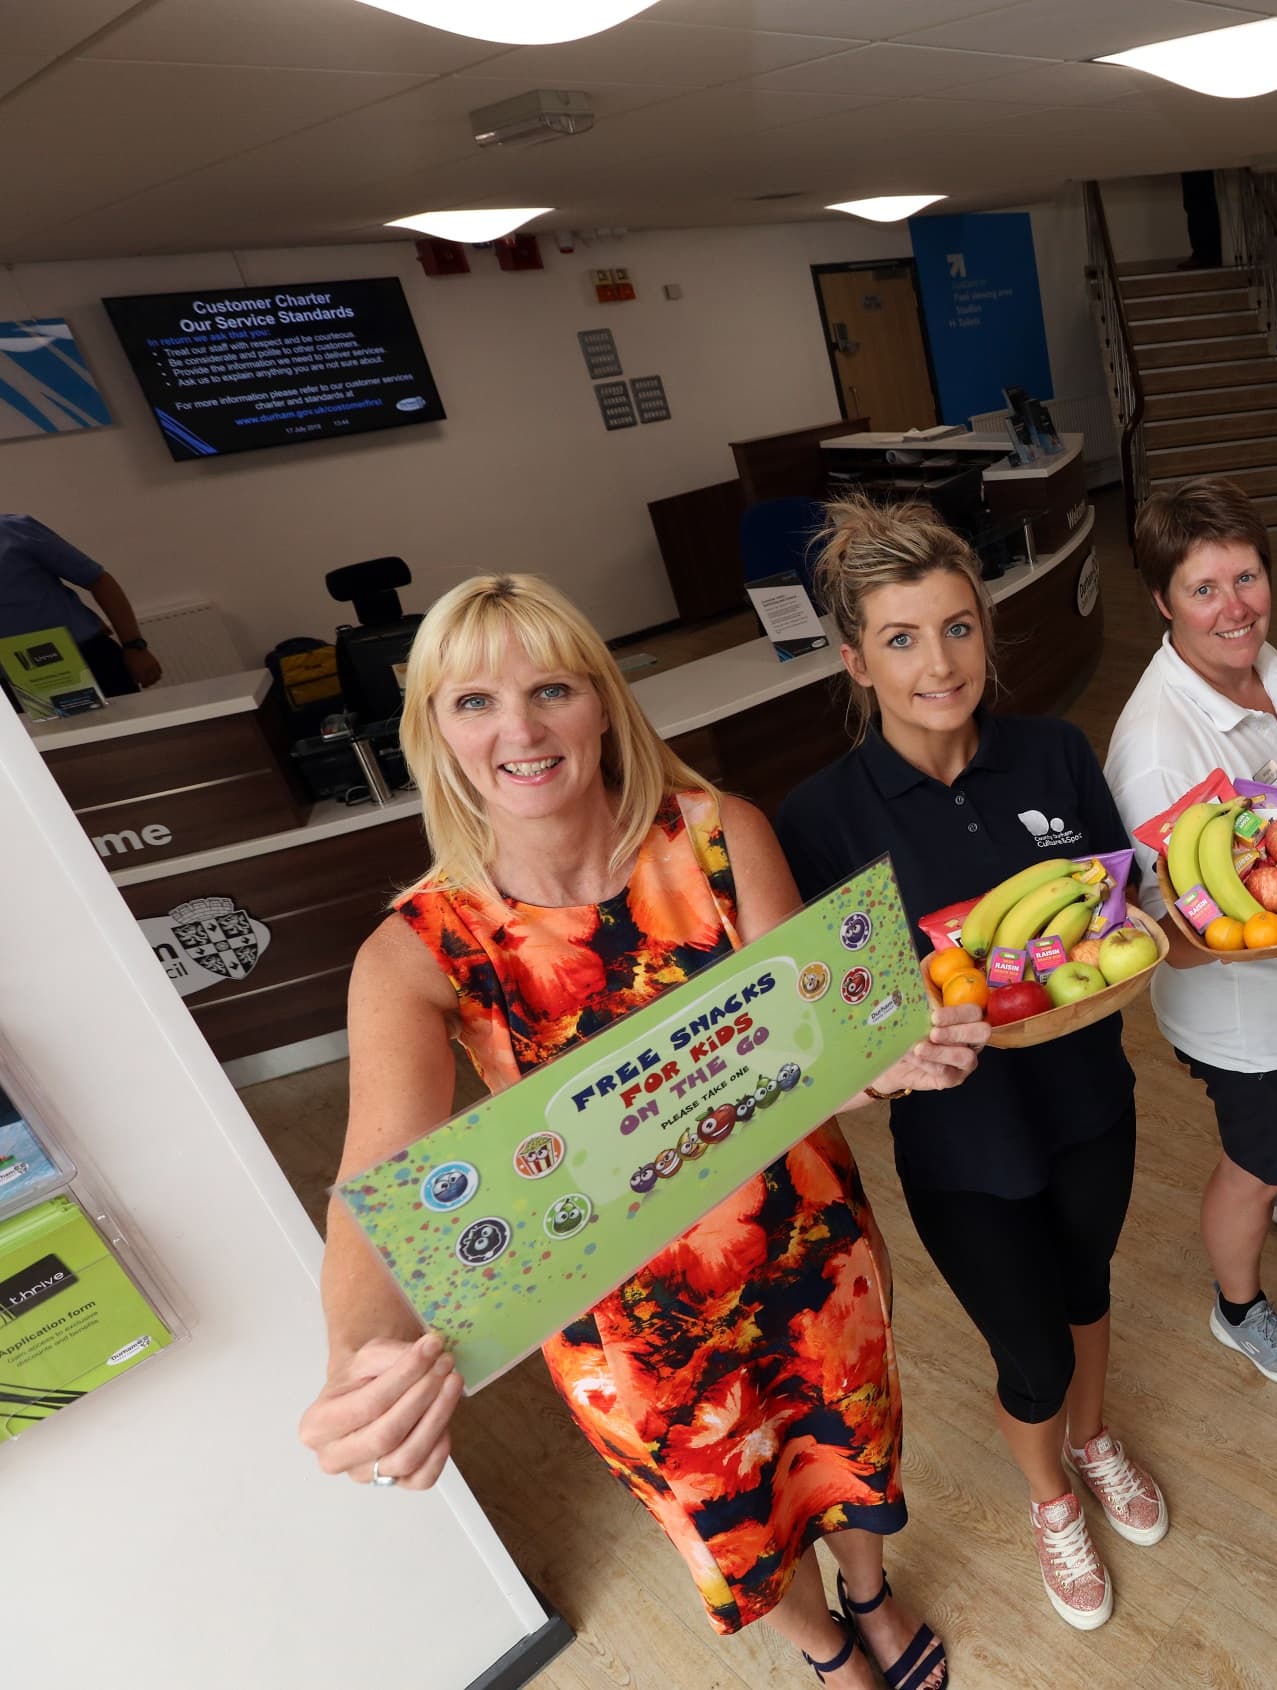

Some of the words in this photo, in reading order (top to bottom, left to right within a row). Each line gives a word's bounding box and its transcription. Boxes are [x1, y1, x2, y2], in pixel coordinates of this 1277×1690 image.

[192, 298, 272, 315] Customer
[275, 292, 332, 308] Charter
[179, 319, 212, 333] Our
[214, 313, 276, 330] Service
[278, 305, 355, 325] Standards
[164, 346, 190, 358] Treat
[191, 346, 207, 355] our
[208, 343, 228, 353] staff
[229, 341, 249, 351] with
[249, 336, 282, 350] respect
[283, 335, 300, 345] and
[301, 334, 313, 343] be
[168, 358, 183, 368] Be
[184, 353, 238, 366] considerate
[239, 350, 257, 360] and
[257, 347, 281, 359] polite
[282, 346, 292, 355] to
[293, 343, 315, 354] other
[171, 366, 210, 377] Provide
[210, 363, 226, 373] the
[226, 358, 276, 371] information
[276, 356, 291, 366] we
[292, 353, 314, 365] need
[314, 352, 323, 361] to
[323, 350, 351, 360] deliver
[178, 378, 197, 387] Ask
[198, 376, 210, 385] us
[210, 375, 221, 383] to
[221, 371, 255, 383] explain
[255, 366, 295, 380] anything
[295, 365, 309, 375] you
[310, 362, 325, 372] are
[325, 360, 340, 370] not
[340, 359, 359, 369] sure
[175, 401, 193, 411] For
[193, 398, 219, 409] more
[219, 391, 269, 406] information
[269, 388, 299, 402] please
[299, 384, 319, 396] refer
[319, 382, 330, 392] to
[330, 382, 344, 391] our
[344, 377, 381, 390] customer
[382, 373, 414, 383] services
[255, 398, 288, 411] charter
[288, 396, 304, 406] and
[304, 391, 344, 404] standards
[344, 389, 354, 399] at
[995, 962, 1019, 972] RAISIN
[1035, 948, 1060, 959] RAISIN
[871, 1000, 893, 1019] Durham
[571, 1048, 661, 1112] FREE
[670, 972, 776, 1051] SNACKS
[620, 1099, 660, 1136] ON
[669, 1055, 727, 1100] THE
[736, 1026, 769, 1056] GO
[620, 1060, 680, 1109] FOR
[661, 1100, 700, 1131] PLEASE
[701, 1082, 728, 1102] TAKE
[729, 1066, 750, 1082] ONE
[9, 1271, 65, 1305] thrive
[0, 1315, 66, 1358] Application
[68, 1301, 96, 1320] form
